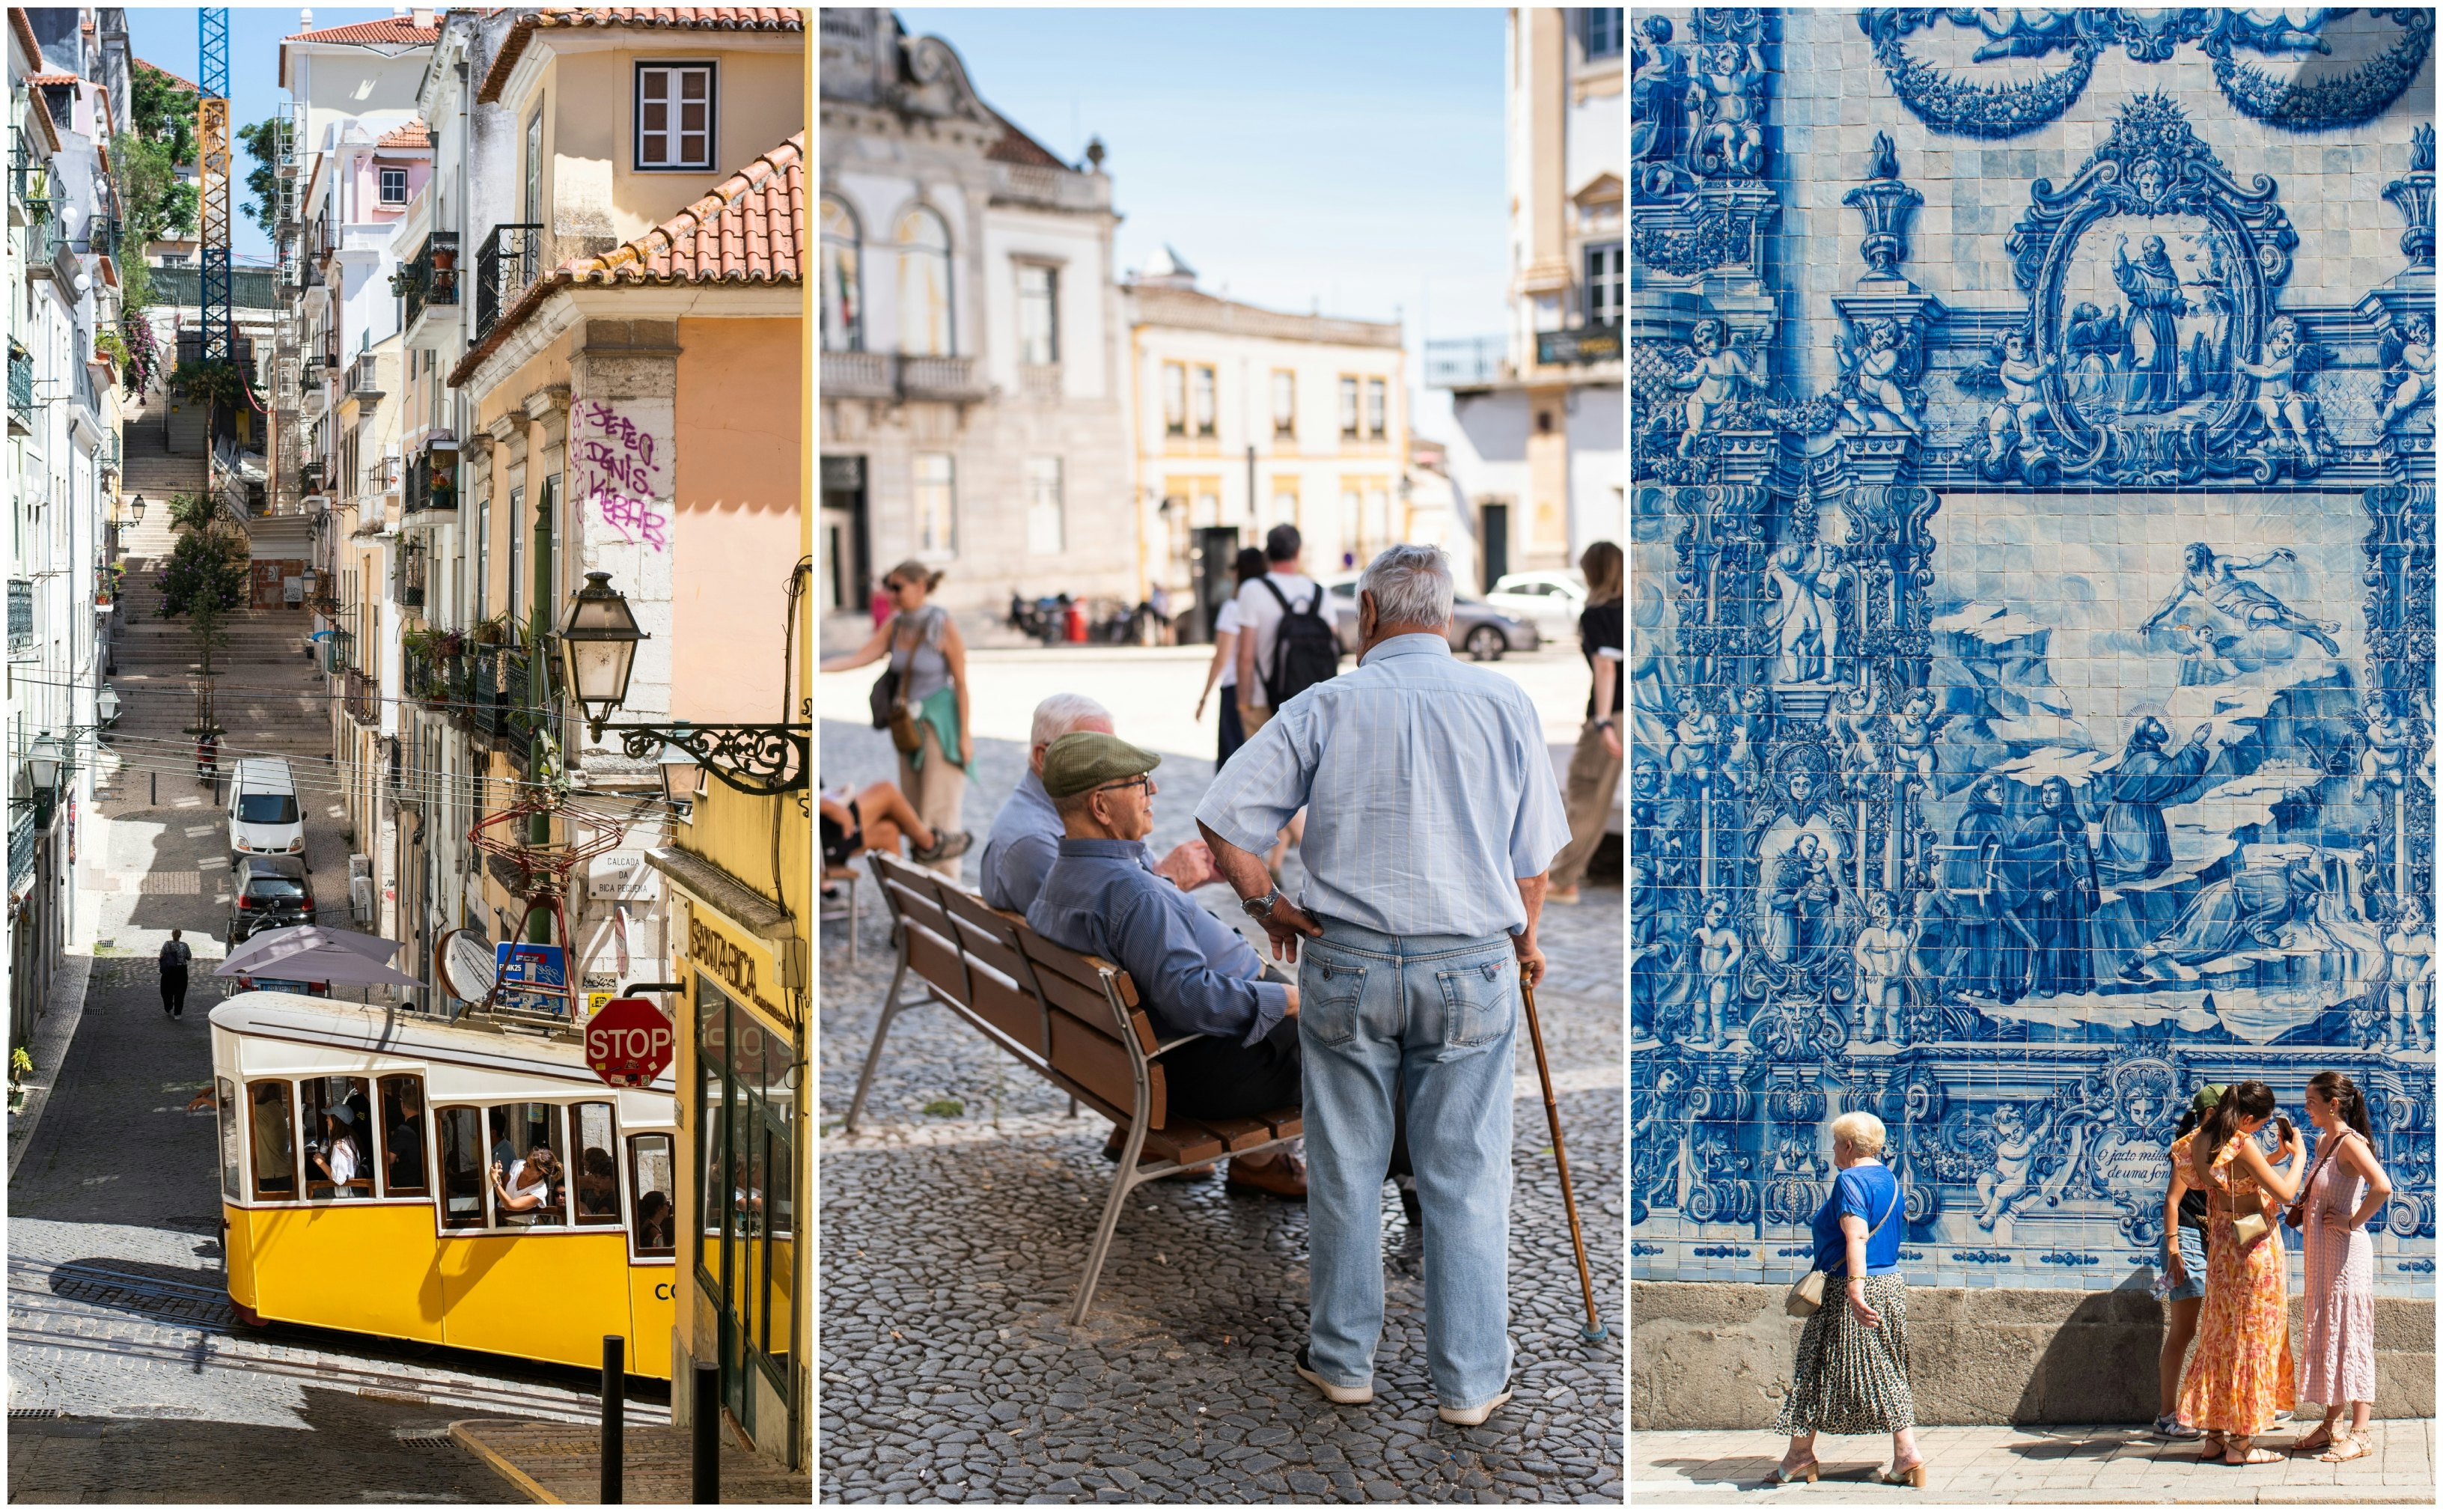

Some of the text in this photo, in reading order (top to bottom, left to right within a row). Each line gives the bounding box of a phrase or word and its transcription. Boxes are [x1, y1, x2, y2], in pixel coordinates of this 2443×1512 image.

[600, 884, 614, 892] BICA
[498, 963, 522, 972] FNK25
[589, 1028, 671, 1059] STOP
[2098, 1149, 2108, 1161] O
[2105, 1150, 2137, 1165] jacto
[2108, 1165, 2122, 1178] de
[2123, 1170, 2147, 1179] uma
